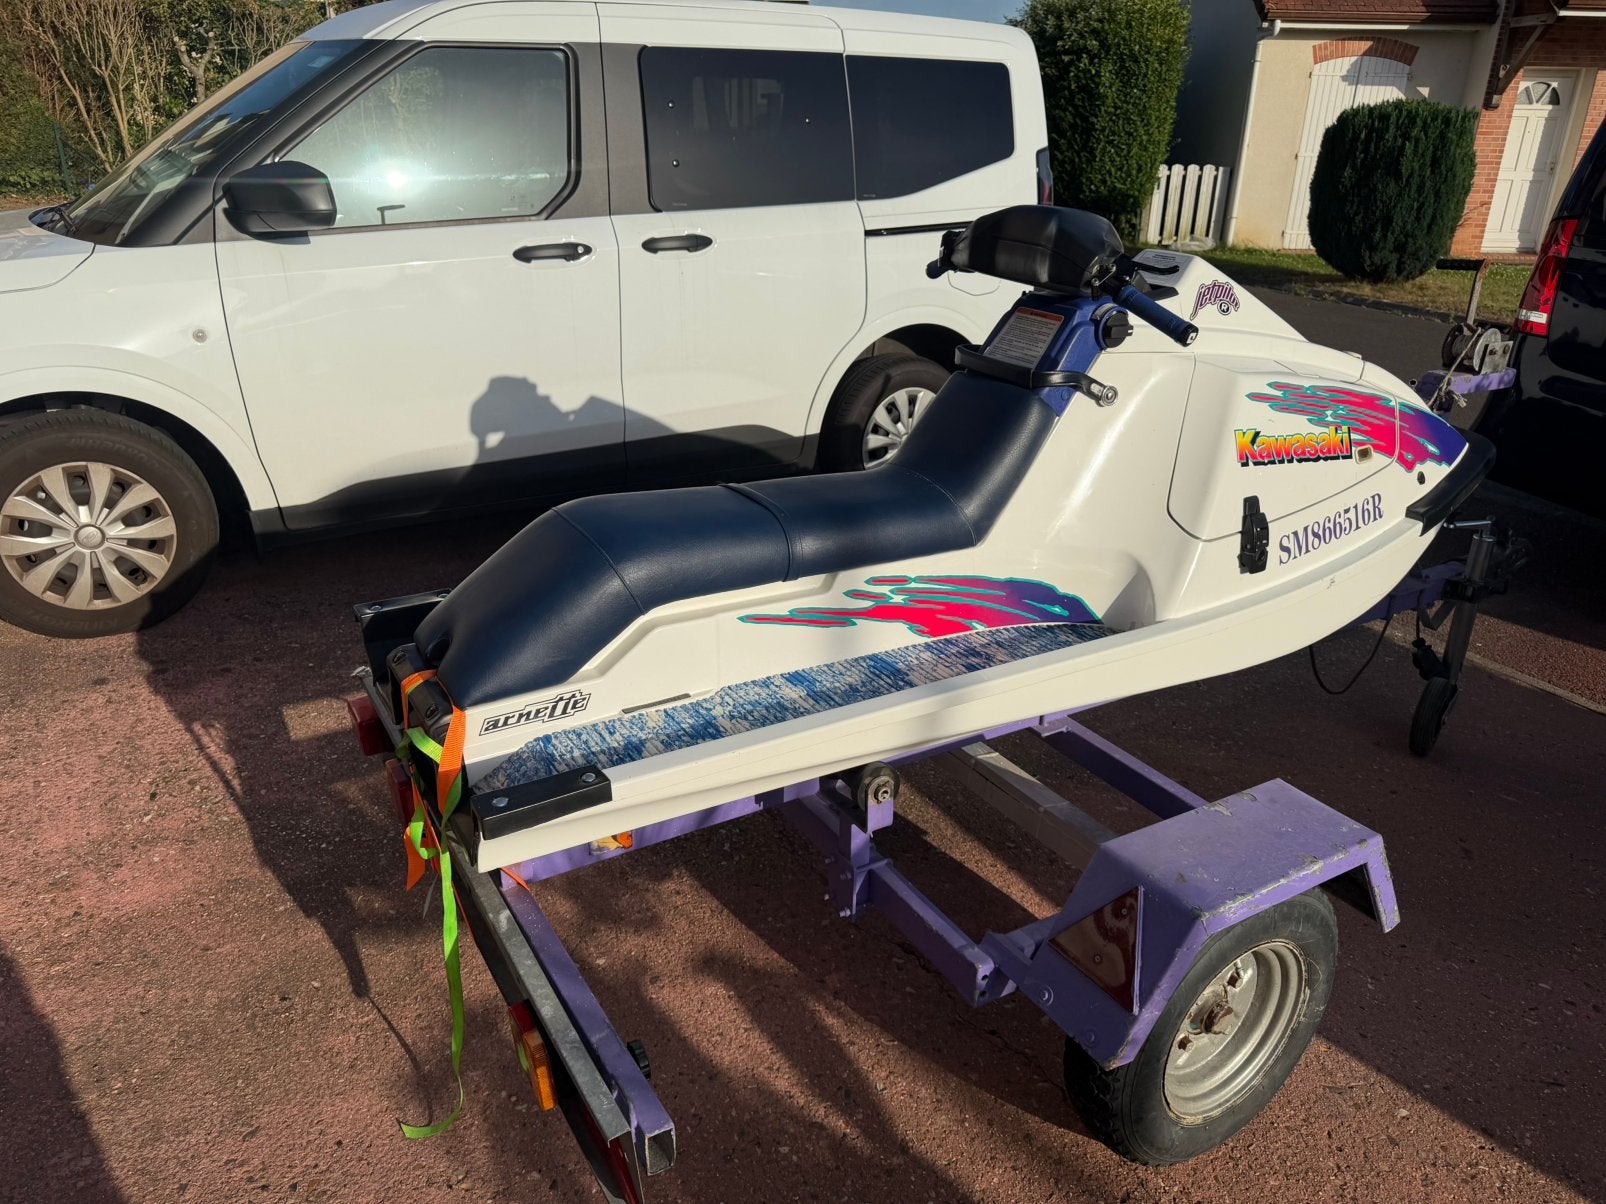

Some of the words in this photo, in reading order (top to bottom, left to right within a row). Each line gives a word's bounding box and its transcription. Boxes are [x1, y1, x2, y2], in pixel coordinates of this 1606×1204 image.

[1234, 425, 1352, 467] Kawasaki
[1279, 492, 1384, 566] SM866516R
[482, 692, 588, 733] arnette
